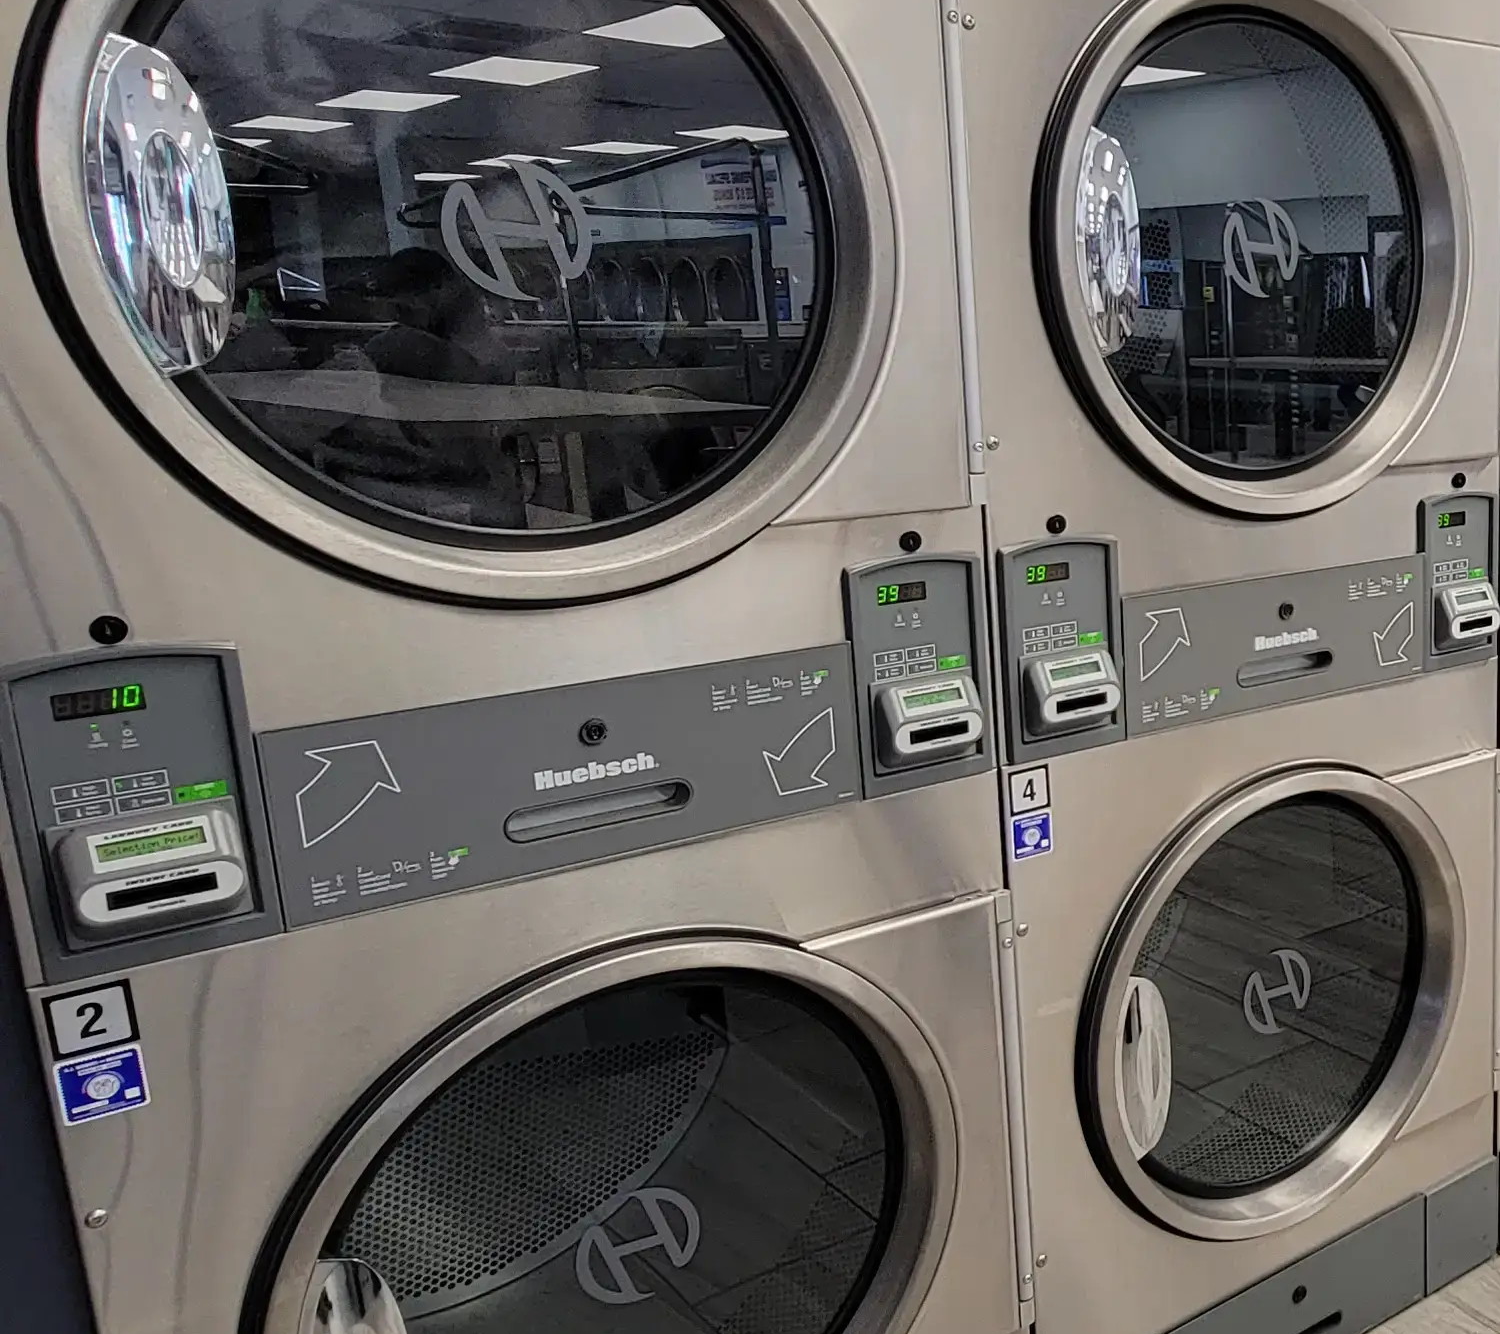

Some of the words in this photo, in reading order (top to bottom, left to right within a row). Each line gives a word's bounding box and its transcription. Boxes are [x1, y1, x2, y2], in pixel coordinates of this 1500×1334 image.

[1027, 565, 1047, 583] 39
[878, 584, 900, 605] 39
[111, 684, 141, 710] 10
[534, 752, 660, 792] Huebsch
[1022, 778, 1037, 802] 4
[76, 1002, 108, 1040] 2
